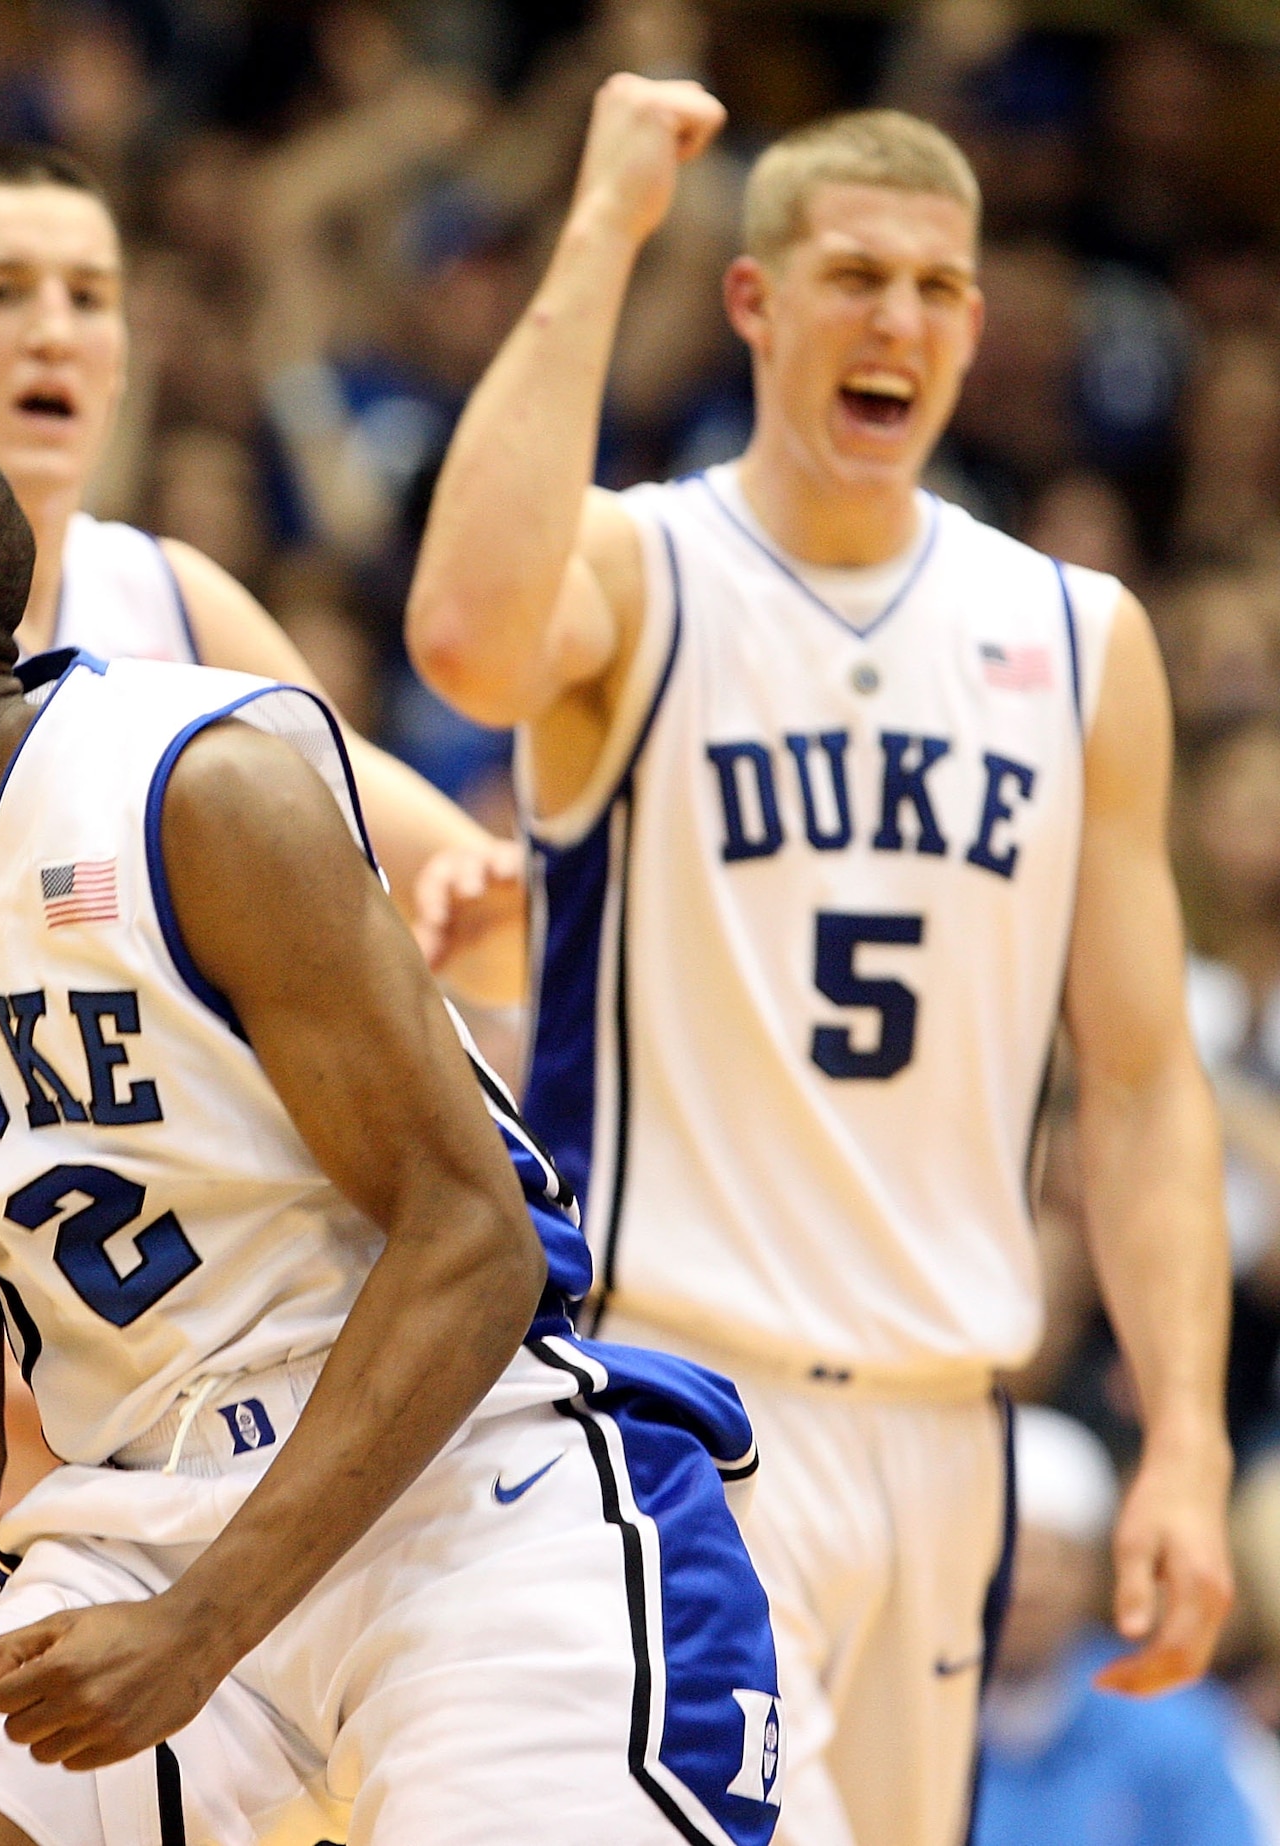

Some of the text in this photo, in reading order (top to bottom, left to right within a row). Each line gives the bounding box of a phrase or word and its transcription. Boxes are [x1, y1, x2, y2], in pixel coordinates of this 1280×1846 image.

[706, 728, 1036, 880] DUKE
[810, 911, 926, 1080] 5
[3, 1163, 203, 1328] 2
